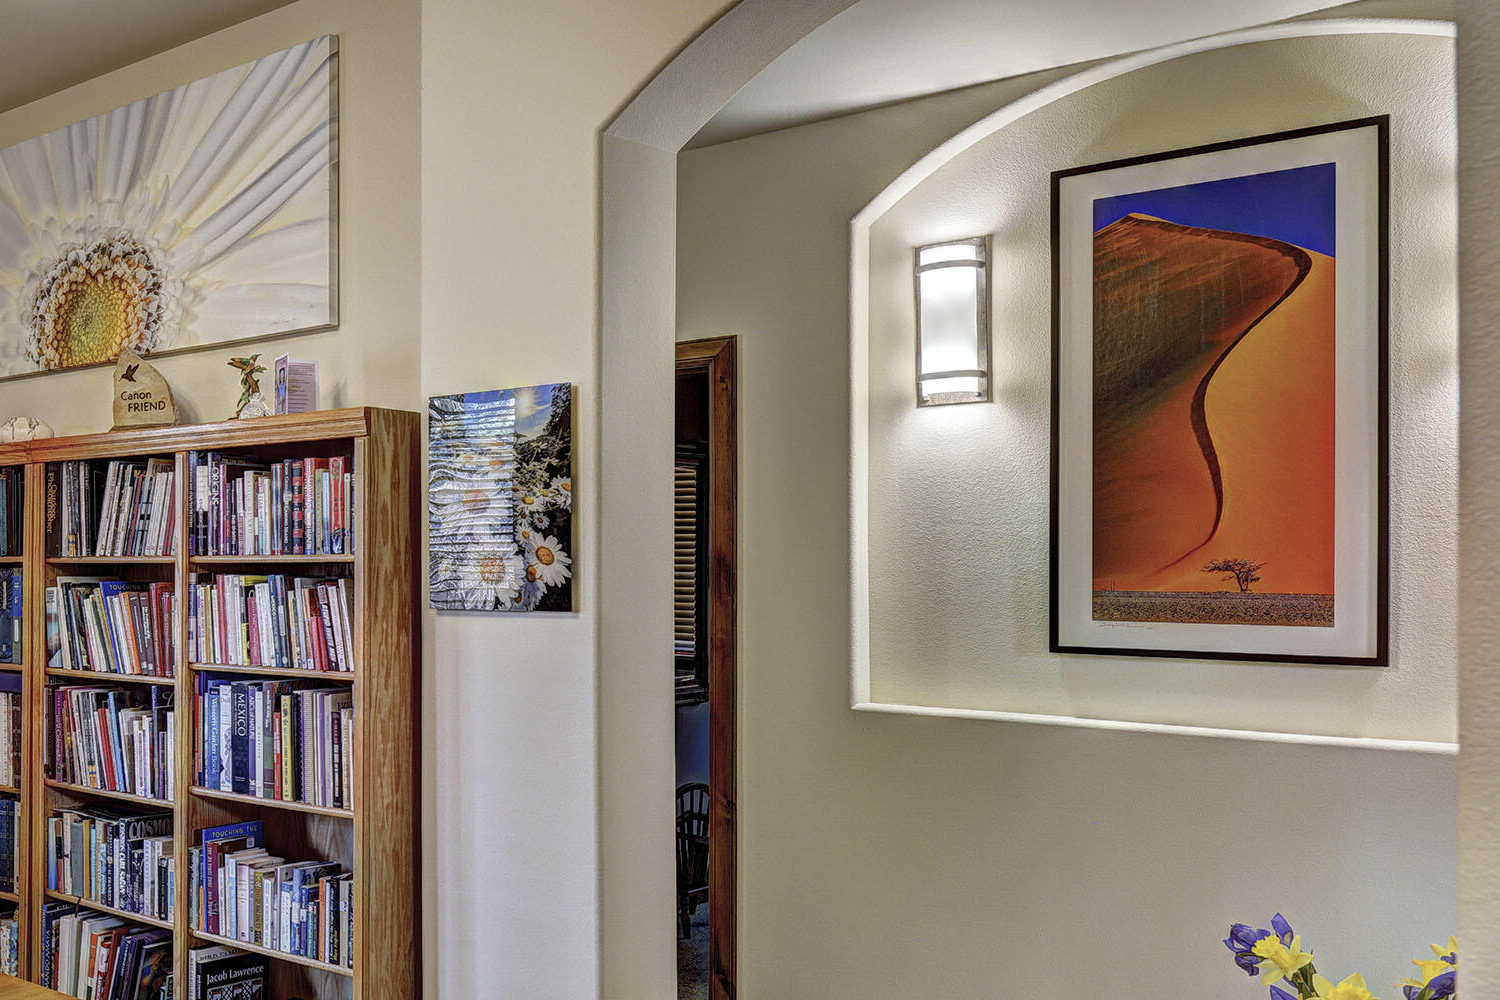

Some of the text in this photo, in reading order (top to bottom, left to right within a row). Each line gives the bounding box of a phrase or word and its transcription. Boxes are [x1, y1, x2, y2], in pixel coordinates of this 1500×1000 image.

[127, 401, 166, 412] FRIEND
[211, 467, 219, 505] ORIGINS
[322, 604, 331, 627] STUPID
[326, 627, 334, 648] WHITE
[237, 693, 246, 737] MEXICO
[129, 818, 173, 839] COSMO
[212, 825, 258, 838] TOUCHING THE
[119, 870, 127, 894] SAGAN
[206, 964, 265, 985] Jacob Lawrence
